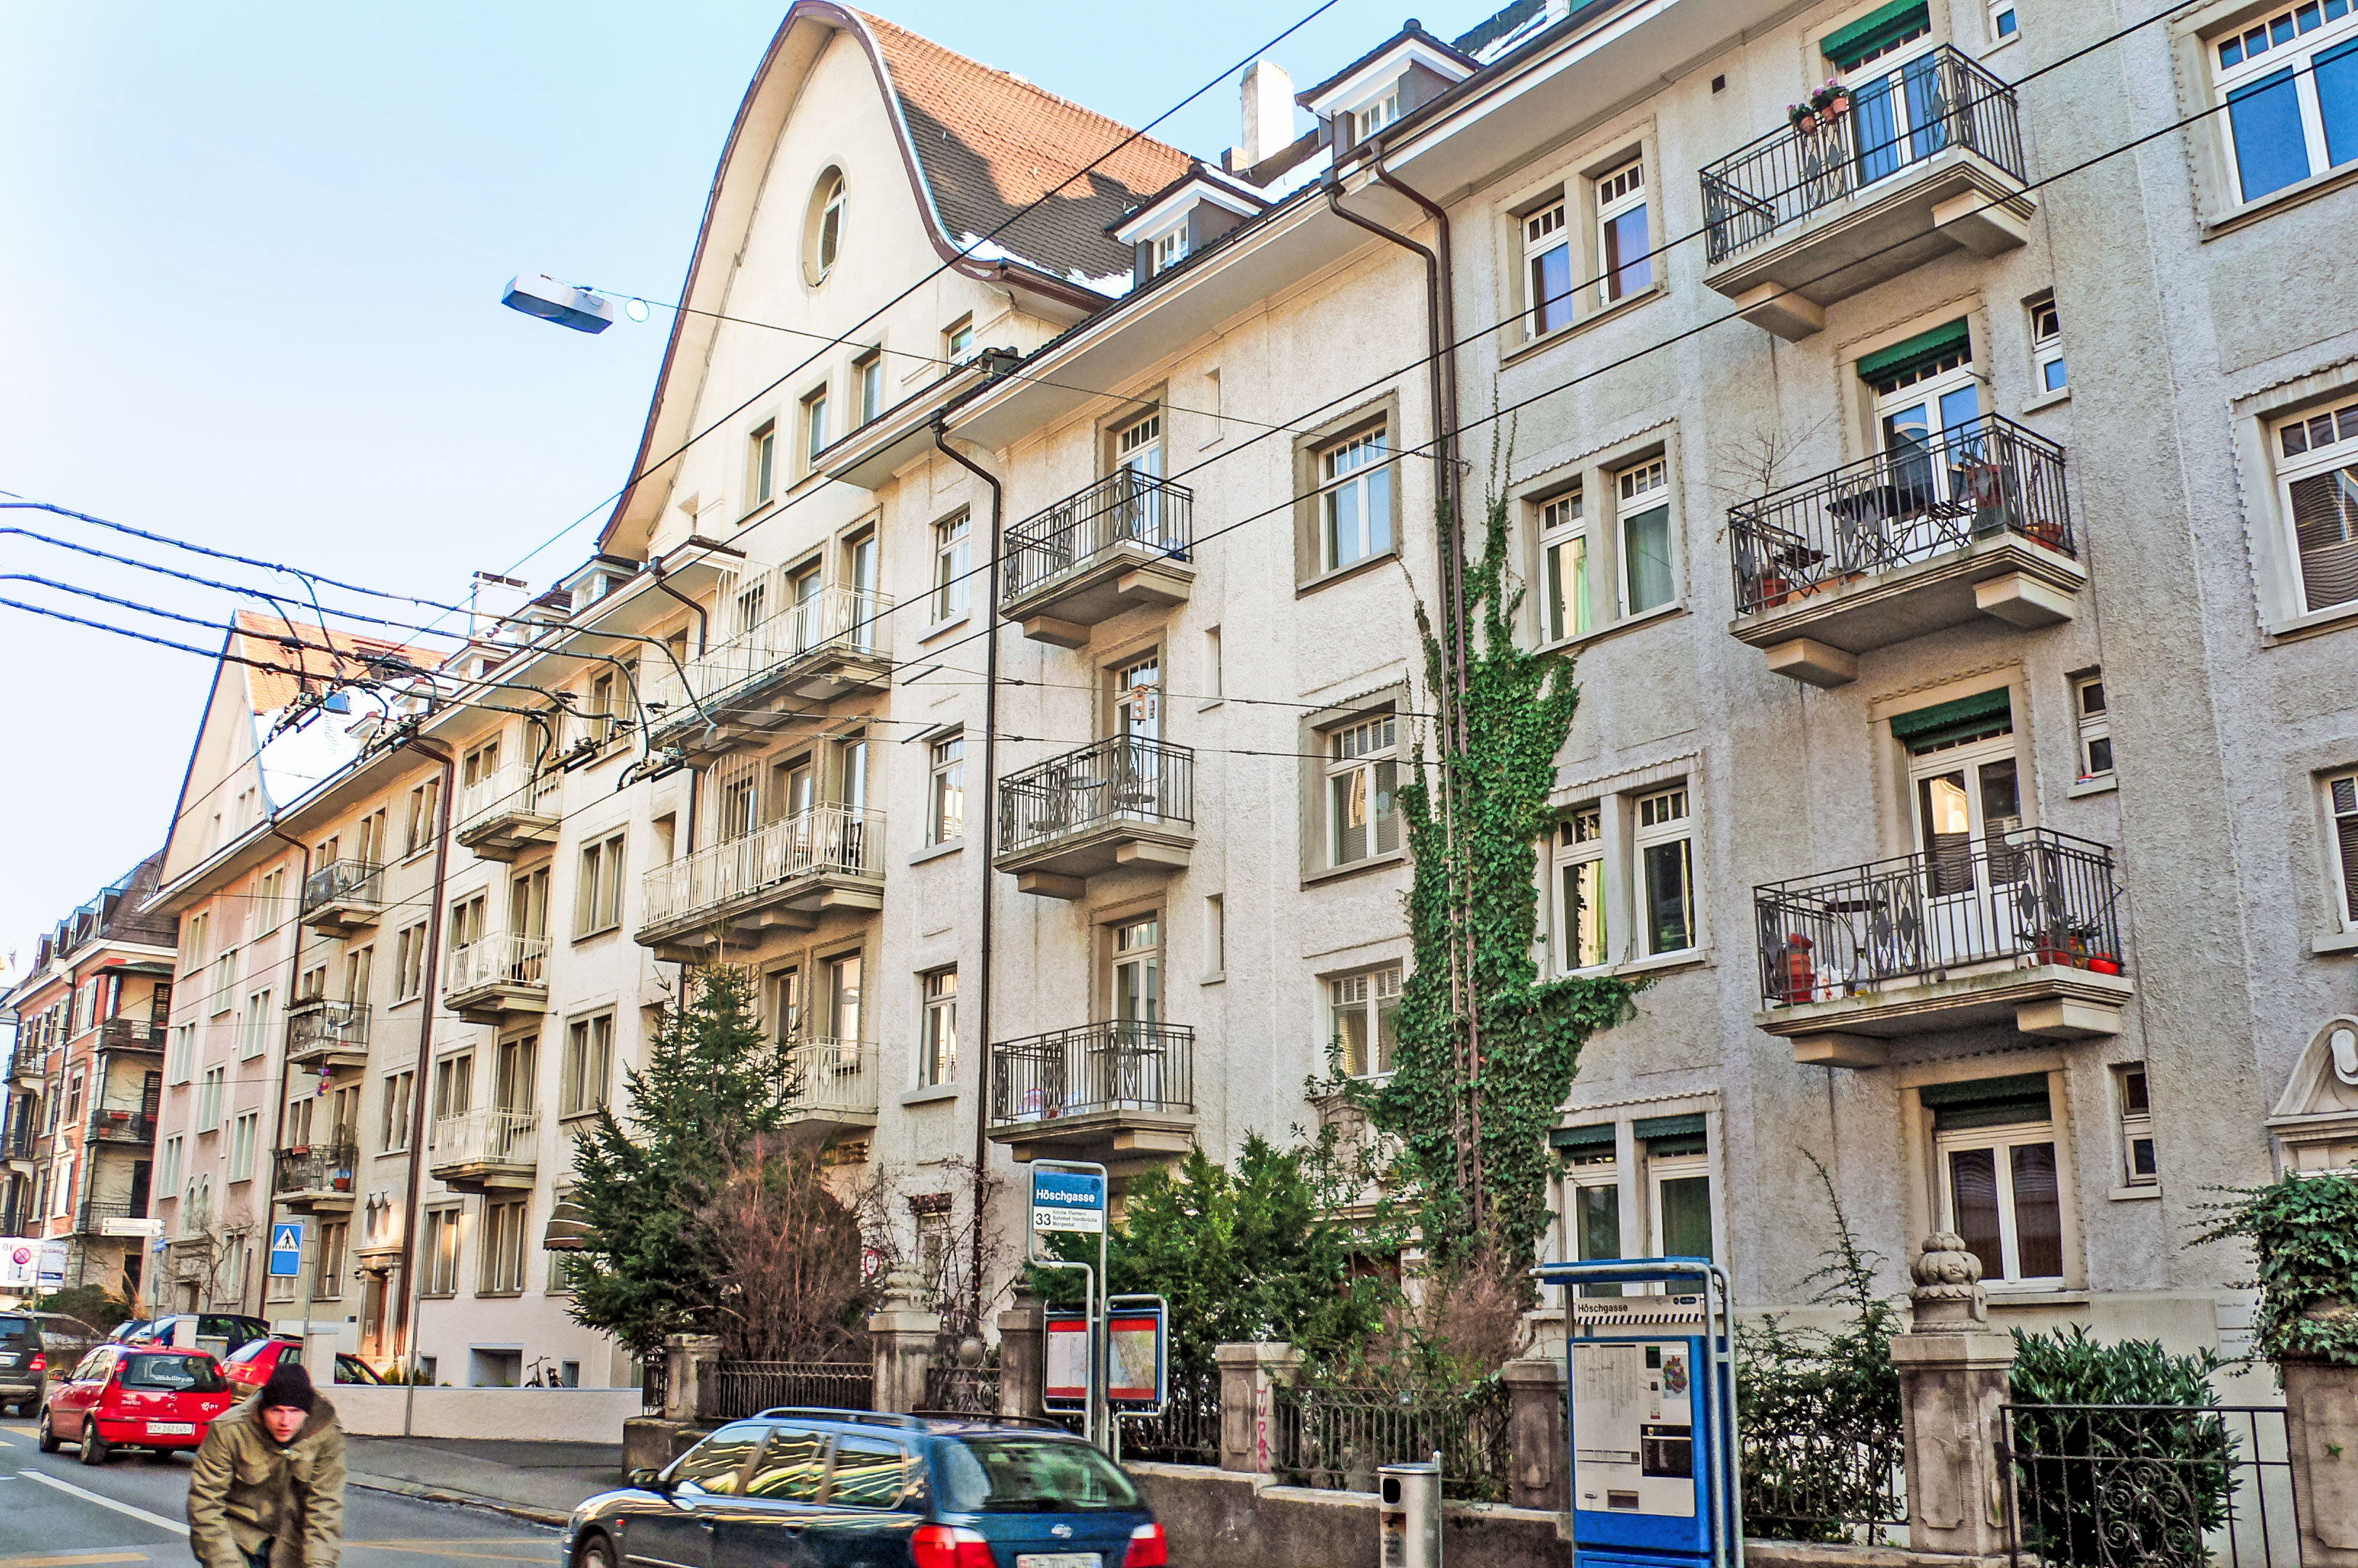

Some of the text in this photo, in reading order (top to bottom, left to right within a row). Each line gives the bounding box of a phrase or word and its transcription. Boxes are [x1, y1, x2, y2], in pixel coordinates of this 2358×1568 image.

[1036, 1188, 1096, 1204] Höschgasse
[1035, 1213, 1051, 1225] 33
[1578, 1303, 1628, 1314] Höschgasse
